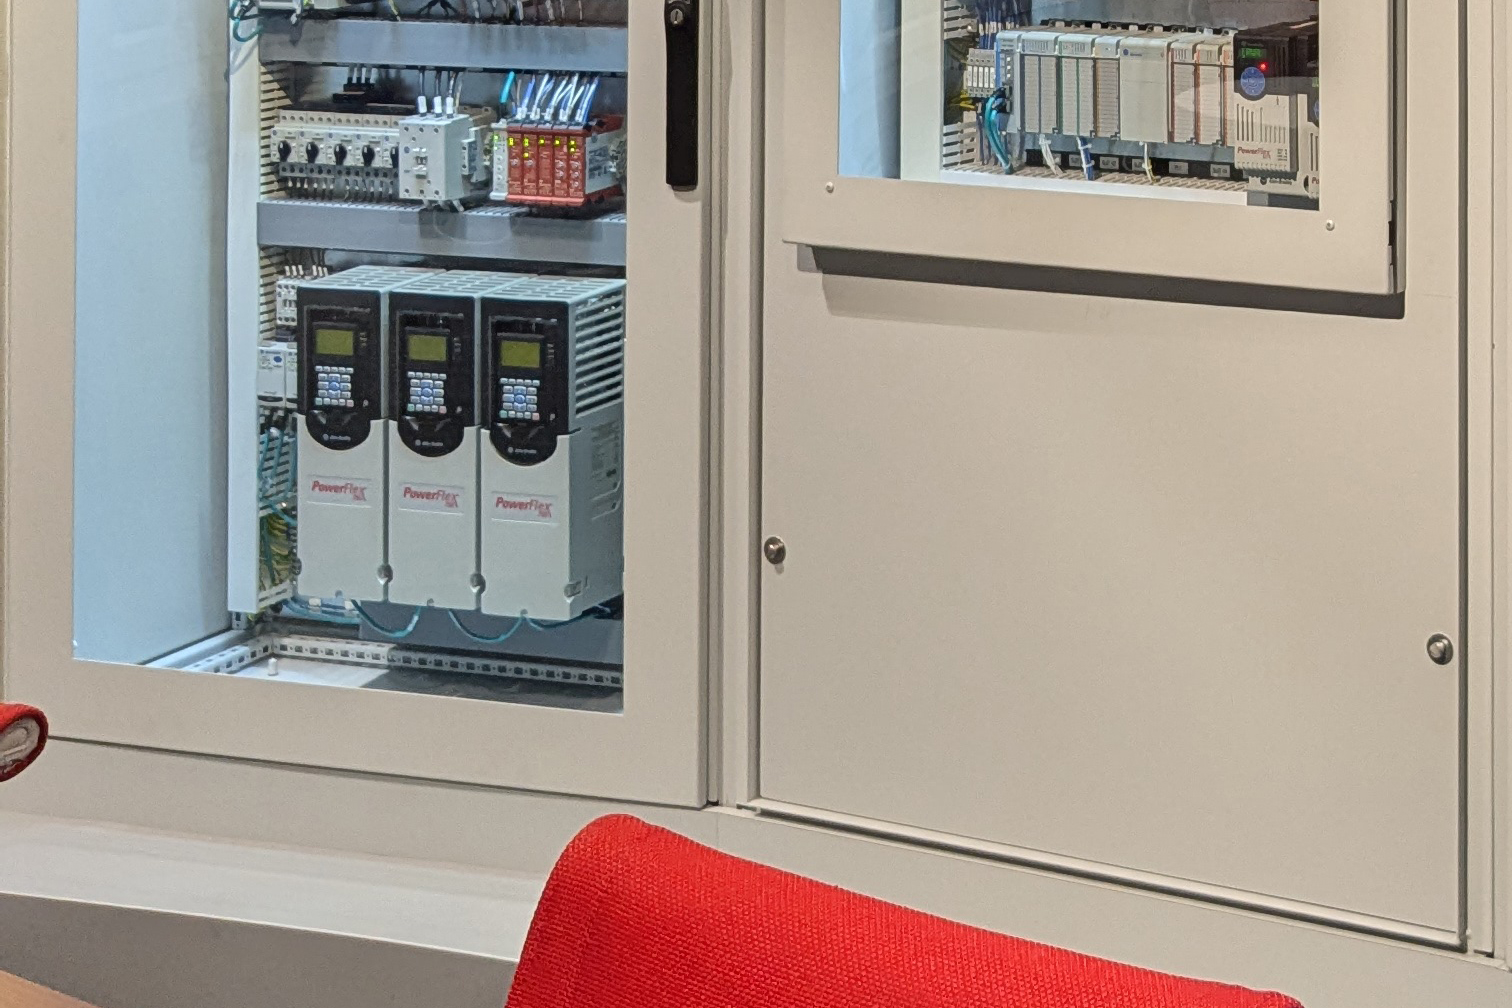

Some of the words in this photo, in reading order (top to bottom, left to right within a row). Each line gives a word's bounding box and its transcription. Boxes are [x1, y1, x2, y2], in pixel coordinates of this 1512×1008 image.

[311, 480, 367, 498] PowerFlex
[403, 486, 459, 504] PowerFlex
[495, 496, 552, 514] PowerFlex
